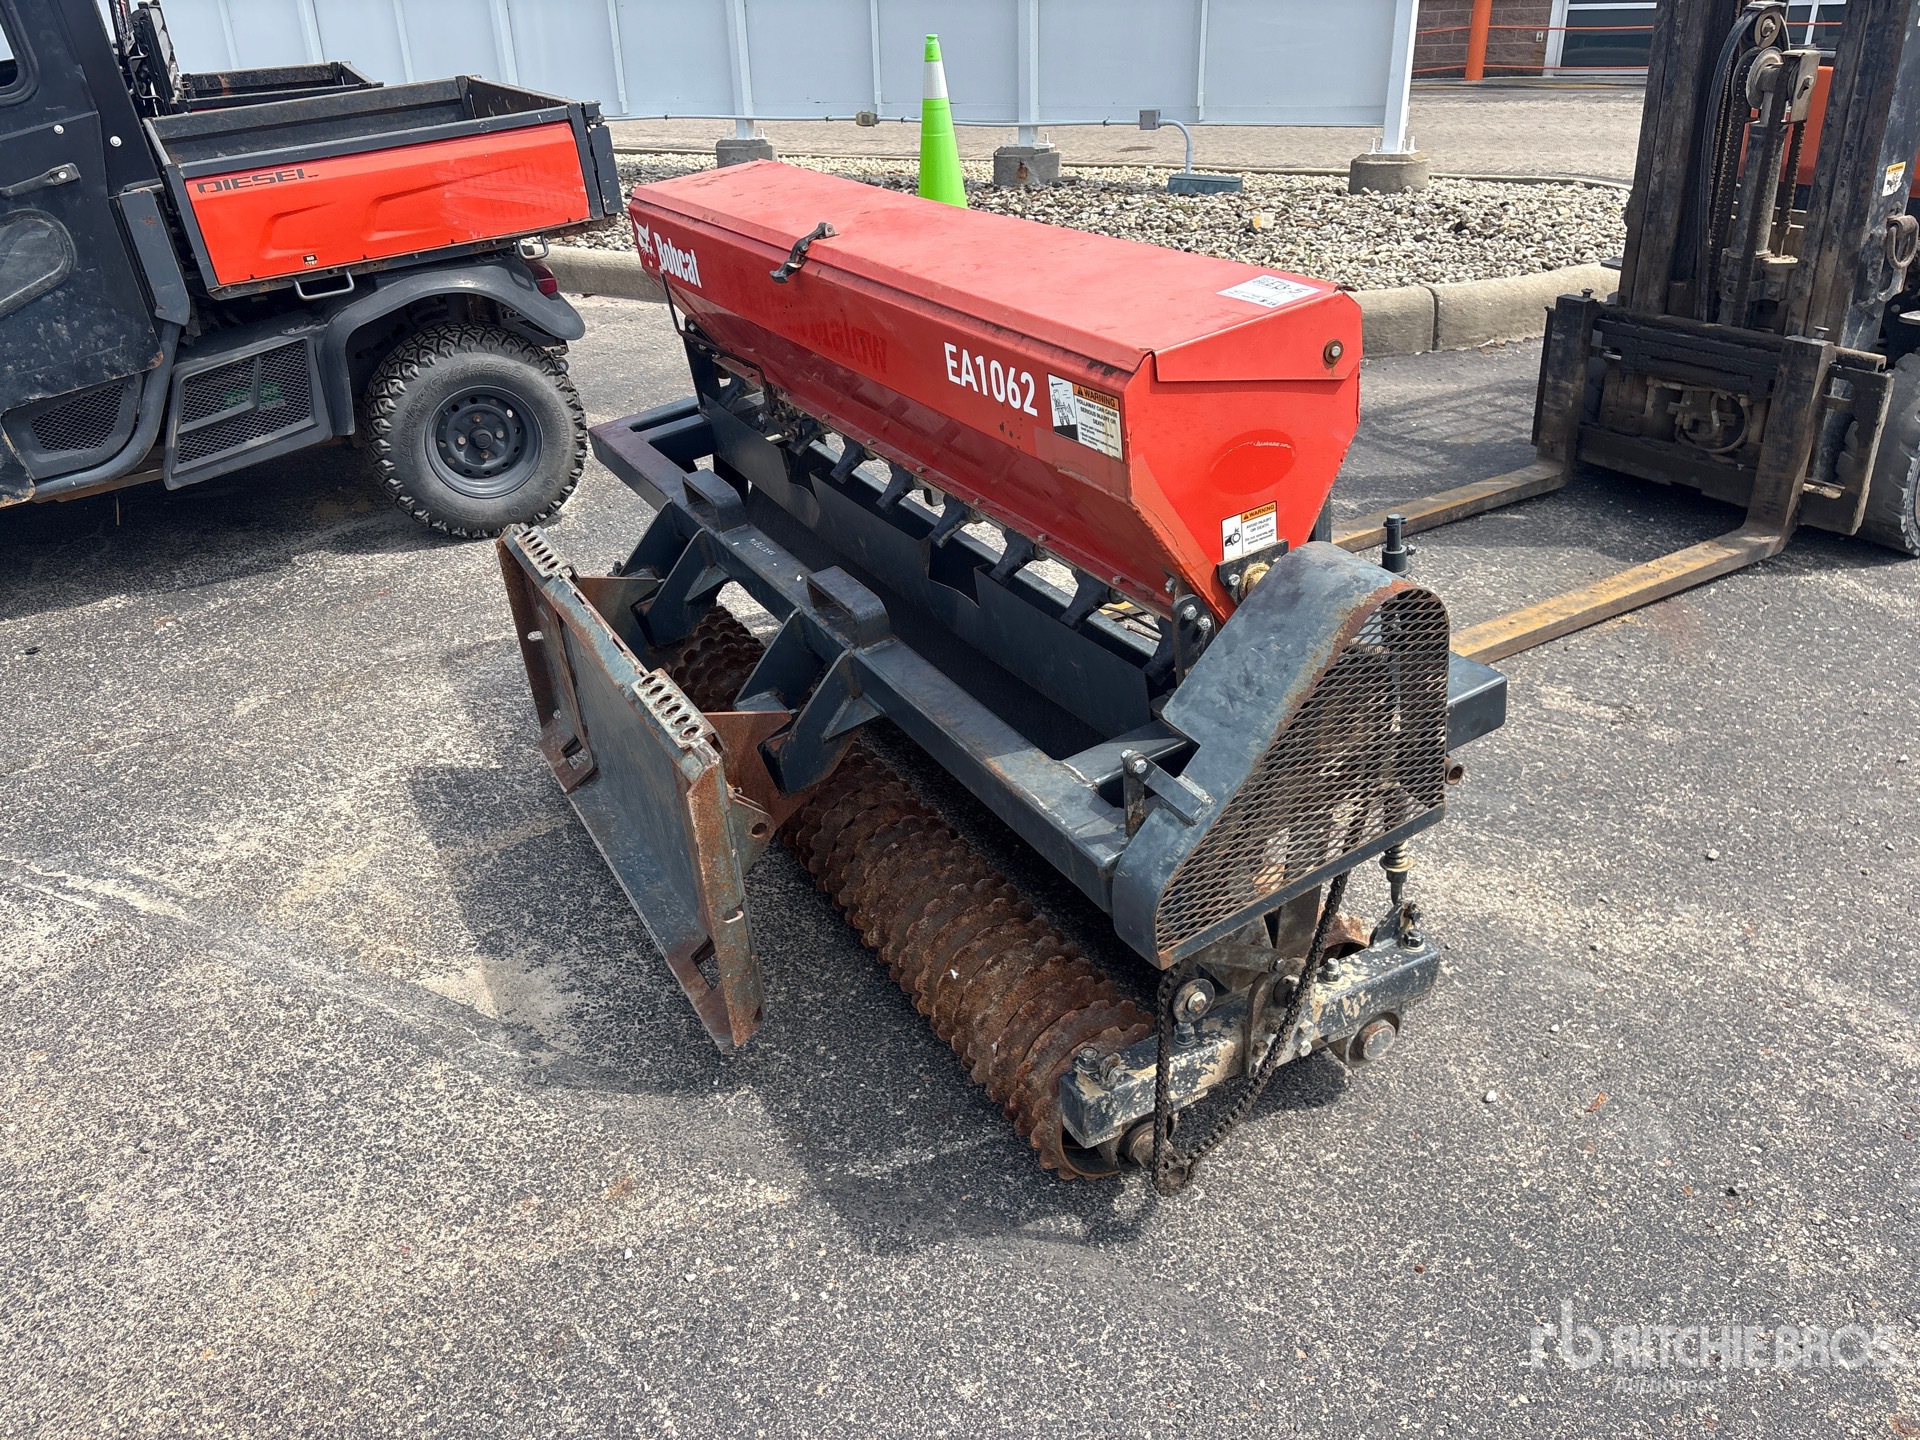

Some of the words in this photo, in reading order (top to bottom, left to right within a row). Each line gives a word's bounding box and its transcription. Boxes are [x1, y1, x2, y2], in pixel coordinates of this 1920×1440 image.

[653, 232, 702, 288] Bobcat
[467, 360, 525, 381] ROAD
[944, 342, 1038, 417] EA1062
[1084, 388, 1116, 407] WARNING
[1080, 407, 1097, 418] SERIOUS
[1097, 405, 1105, 414] CAN
[1105, 409, 1118, 419] CAUSE
[1249, 504, 1274, 517] WARNING
